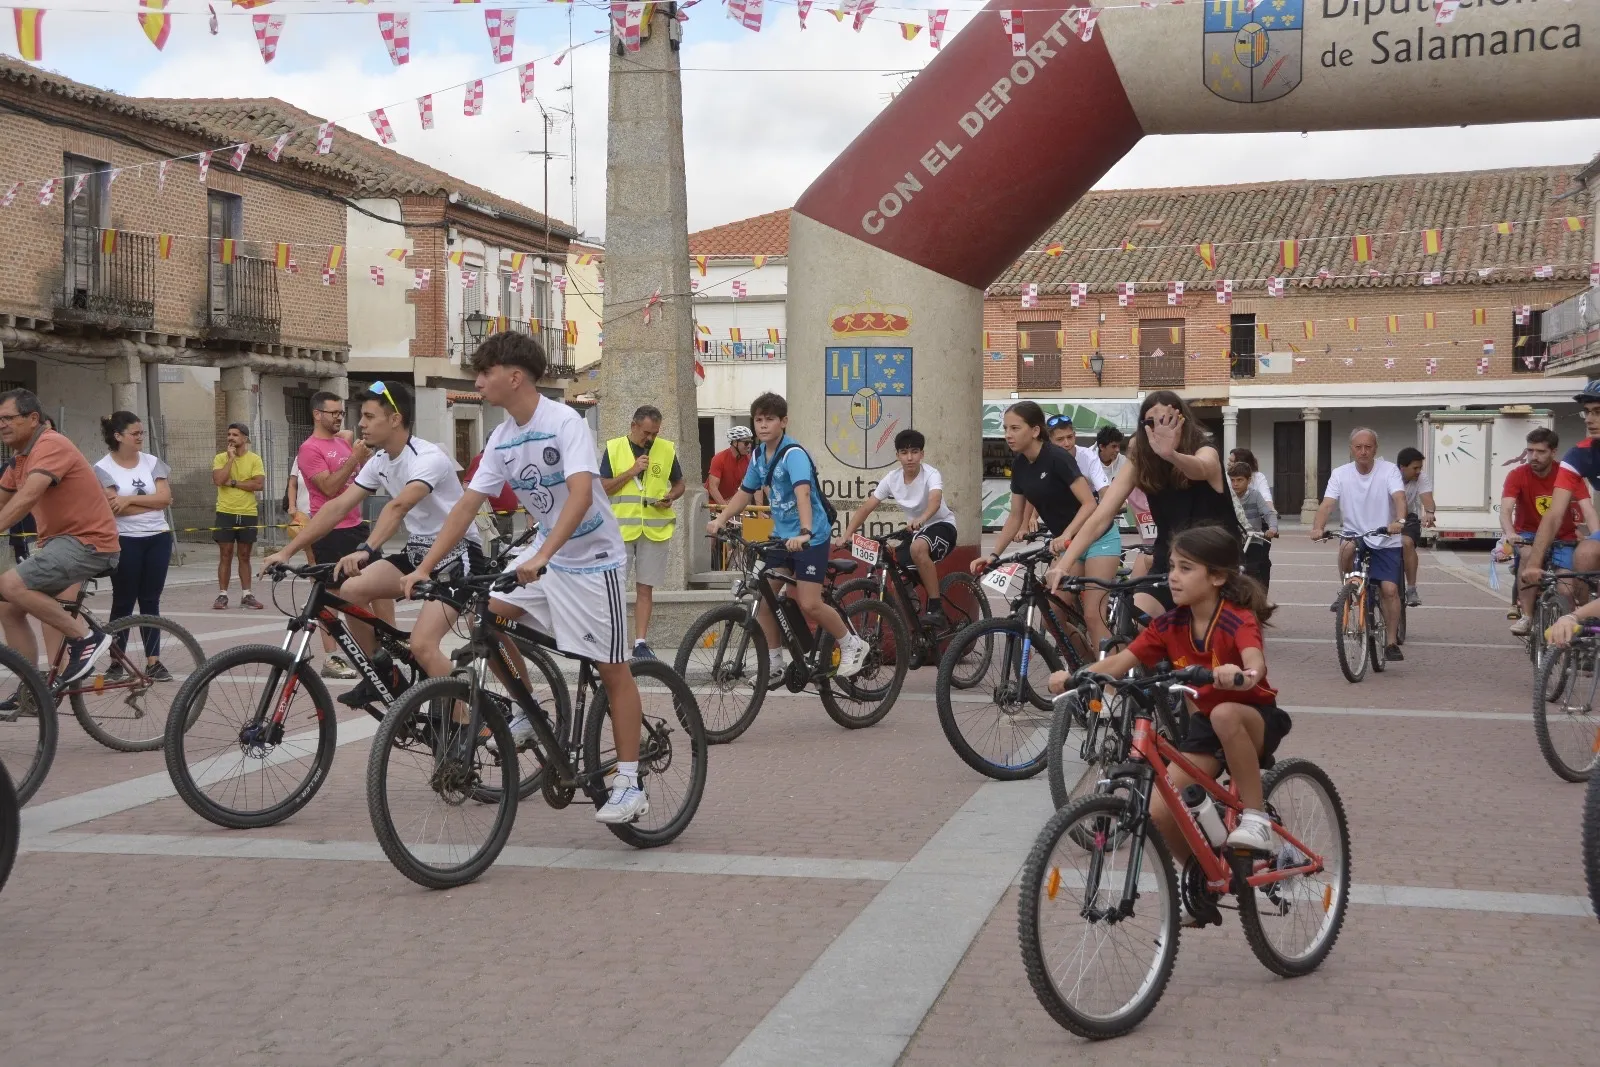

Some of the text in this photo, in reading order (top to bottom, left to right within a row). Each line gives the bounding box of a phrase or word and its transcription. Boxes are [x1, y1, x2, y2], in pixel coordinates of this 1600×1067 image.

[1321, 22, 1581, 68] de Salamanca
[862, 4, 1083, 235] CON EL DEPORTE
[856, 547, 875, 562] 1305
[339, 633, 396, 704] ROCKRIDE
